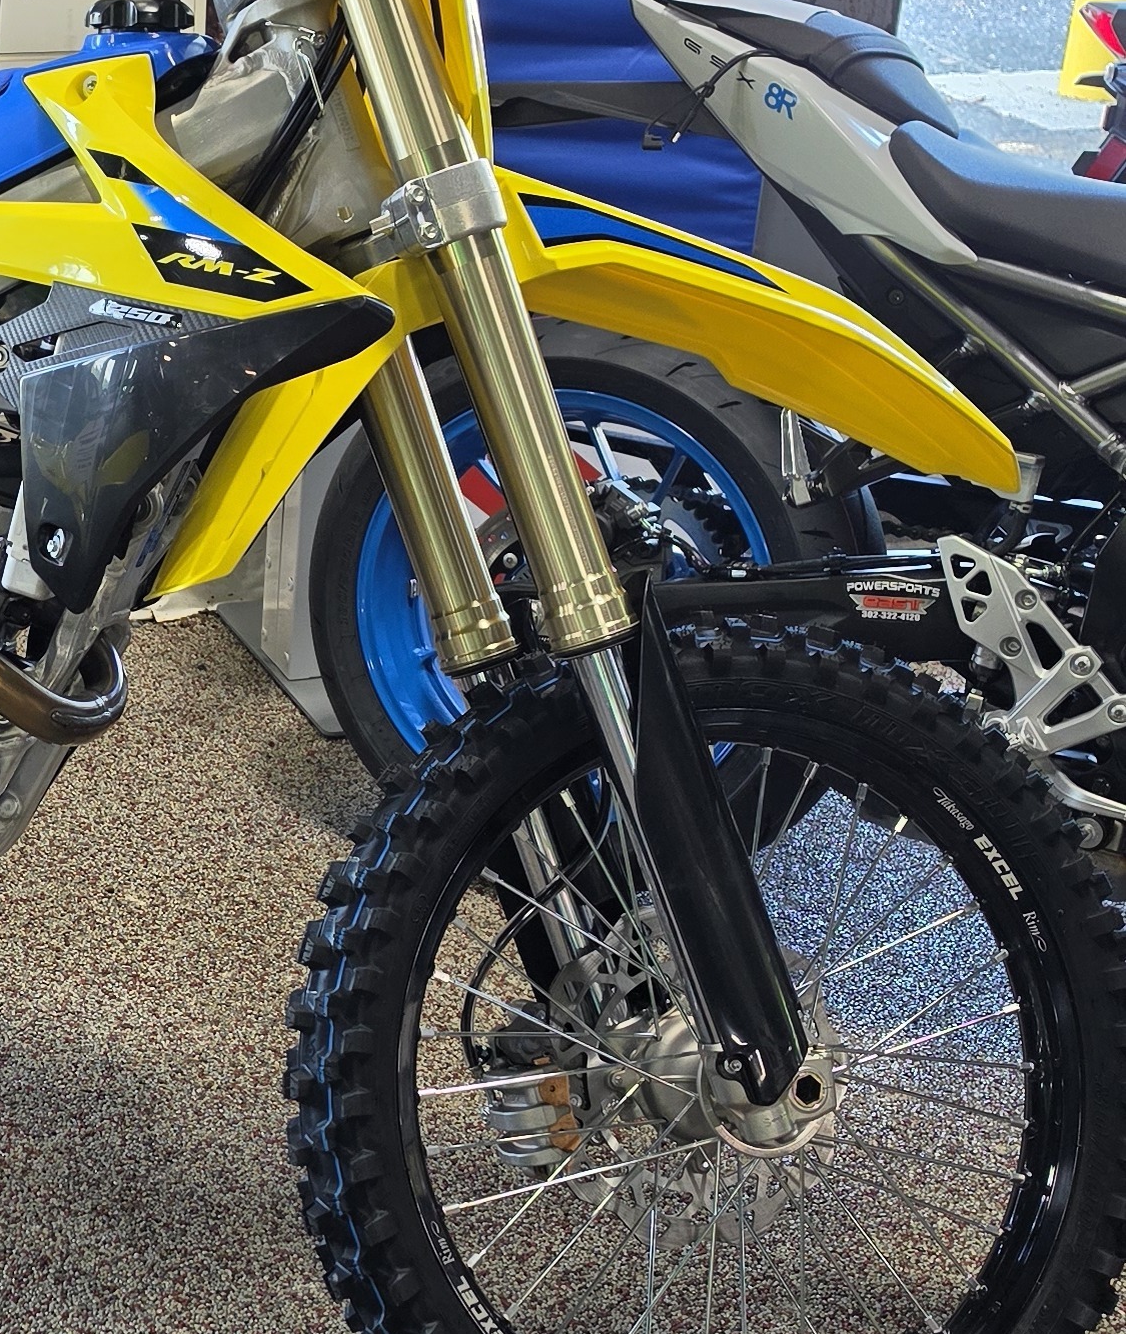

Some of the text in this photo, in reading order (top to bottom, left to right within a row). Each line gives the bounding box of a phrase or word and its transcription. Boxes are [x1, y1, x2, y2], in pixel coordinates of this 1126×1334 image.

[764, 82, 798, 121] 8R
[156, 252, 282, 285] RM-Z
[846, 581, 941, 598] POWERSPORTS
[861, 610, 921, 621] 302-322-4120
[932, 786, 1048, 953] Takasago EXCEL Rim
[430, 1220, 455, 1266] Rim
